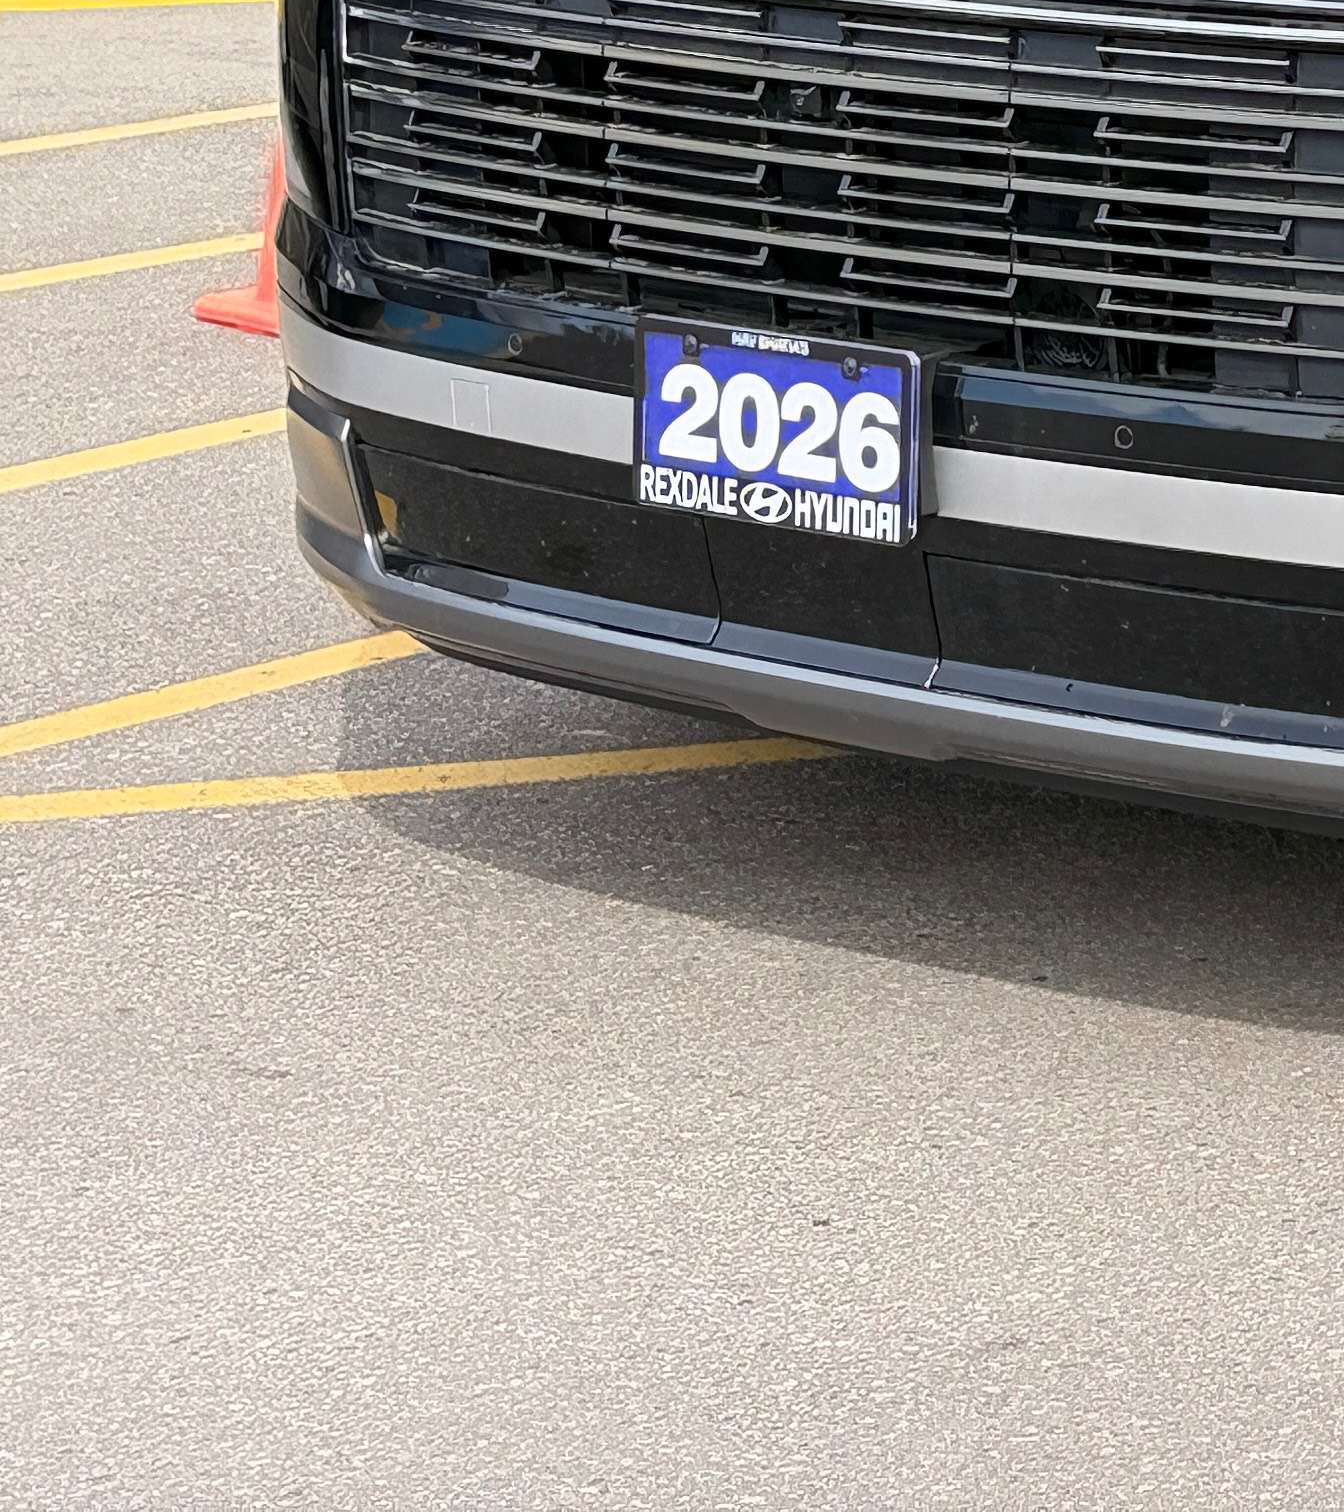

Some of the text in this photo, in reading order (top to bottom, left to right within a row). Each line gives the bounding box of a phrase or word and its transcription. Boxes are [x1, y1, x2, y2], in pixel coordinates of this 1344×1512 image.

[658, 362, 901, 493] 2026
[640, 463, 901, 544] REXDALE HYUNDAI
